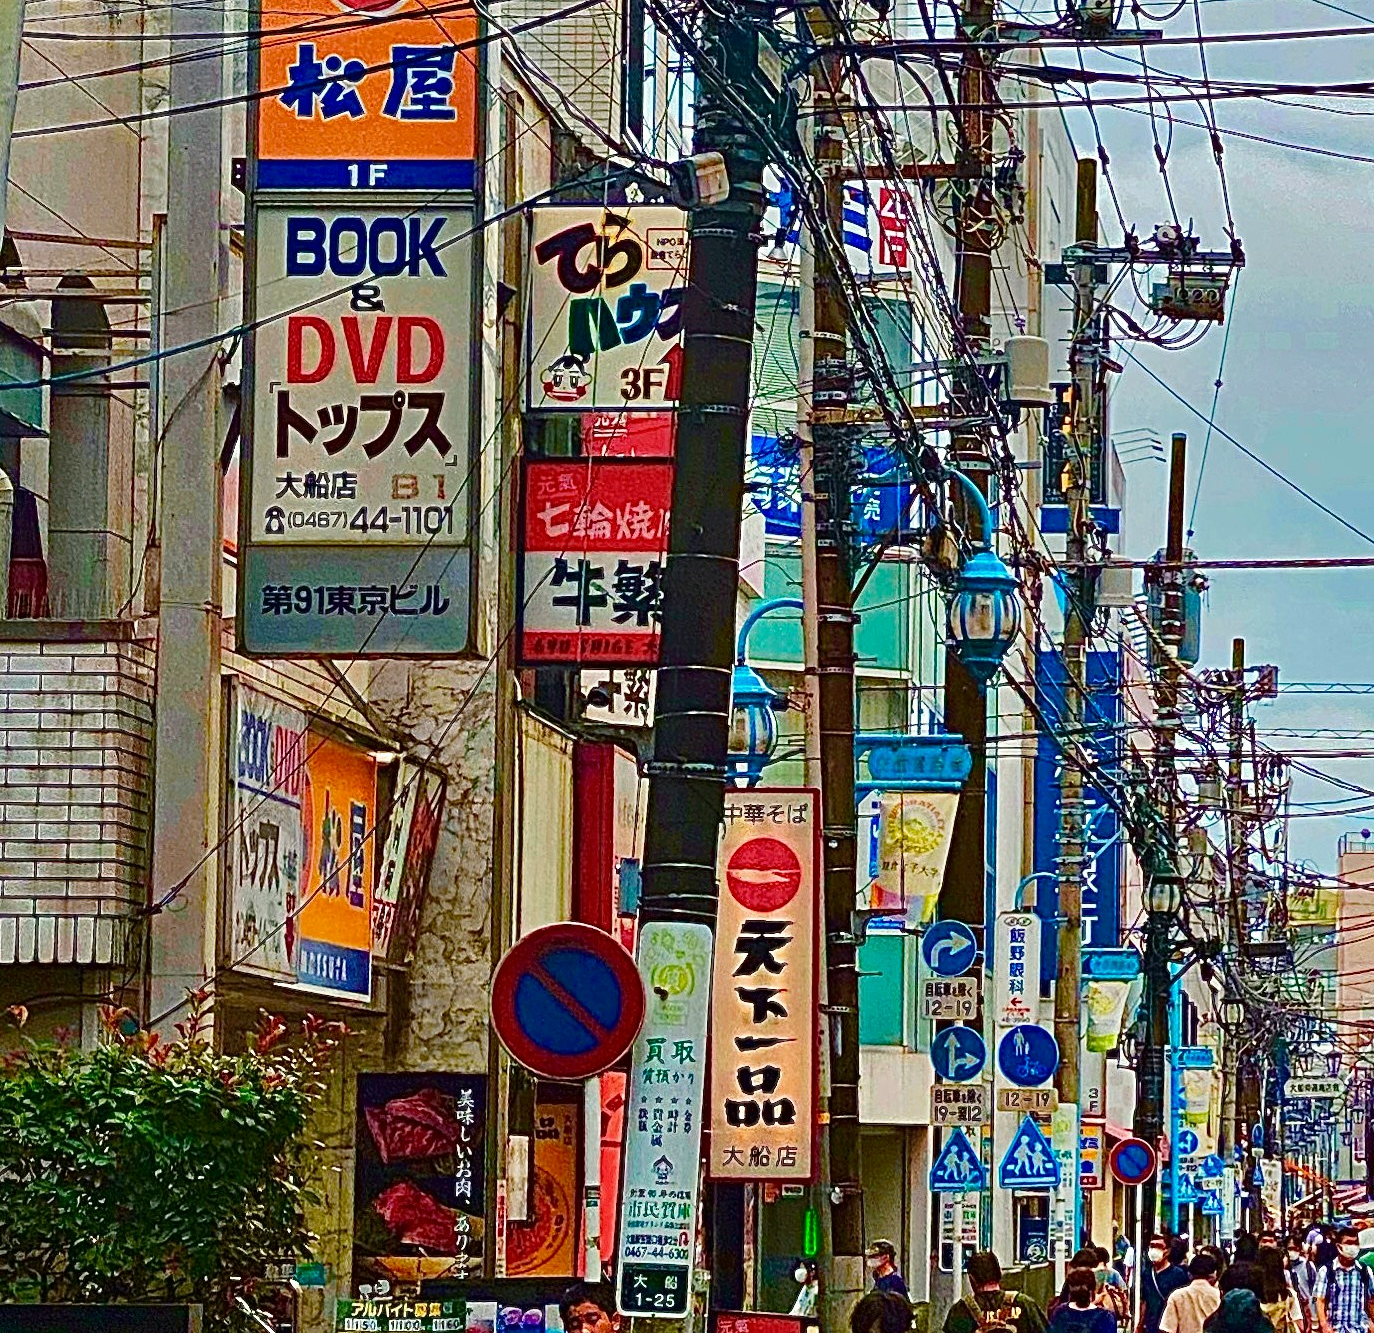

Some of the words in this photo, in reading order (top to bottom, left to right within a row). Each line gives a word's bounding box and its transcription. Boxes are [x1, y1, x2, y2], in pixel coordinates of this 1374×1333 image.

[279, 44, 457, 119] 松屋
[348, 164, 388, 187] 1F
[287, 217, 448, 277] BOOK
[535, 212, 642, 294] てら
[350, 284, 385, 312] &
[286, 316, 447, 384] DVD
[621, 368, 664, 401] 3F
[275, 471, 358, 500] 大船店
[288, 505, 454, 536] (0467)44-1101
[537, 501, 670, 540] 七輪焼
[261, 584, 450, 617] 第91東京ビル
[724, 803, 808, 825] 中華そば
[1009, 928, 1025, 995] 飯野眼科
[926, 983, 973, 998] 自転車を除く
[926, 1000, 972, 1017] 12-19
[724, 919, 797, 1127] 天下一品
[643, 1037, 696, 1064] 買取
[934, 1088, 982, 1104] 自転車を除く
[1005, 1092, 1050, 1107] 12-19
[722, 1145, 799, 1168] 大船店
[633, 1274, 678, 1289] 大船
[636, 1293, 676, 1307] 1-25
